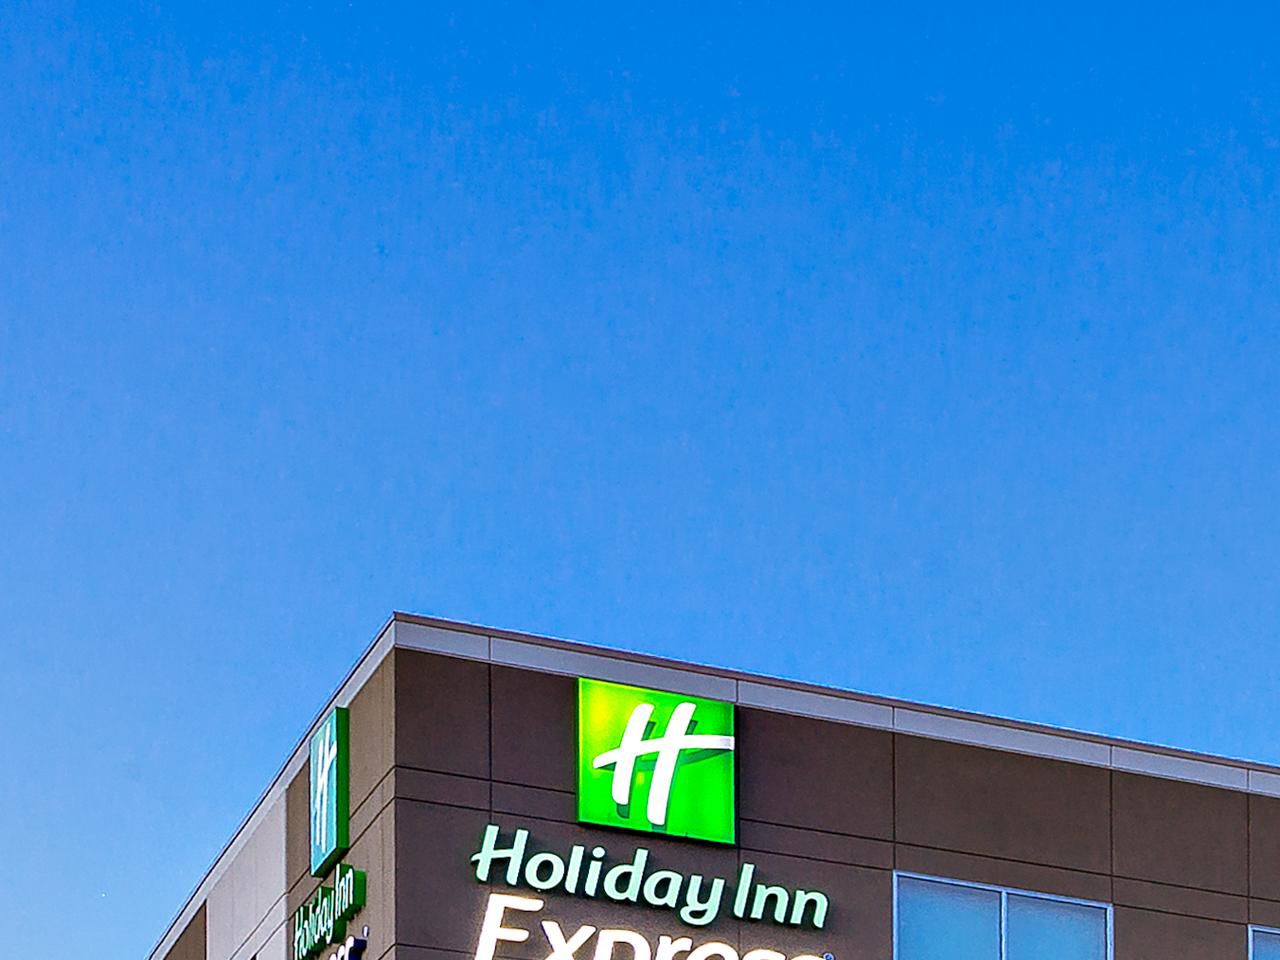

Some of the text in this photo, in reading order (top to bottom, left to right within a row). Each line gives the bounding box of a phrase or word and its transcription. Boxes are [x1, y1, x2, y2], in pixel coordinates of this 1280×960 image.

[592, 702, 735, 825] H
[335, 863, 354, 920] Inn
[470, 824, 829, 929] Holiday Inn
